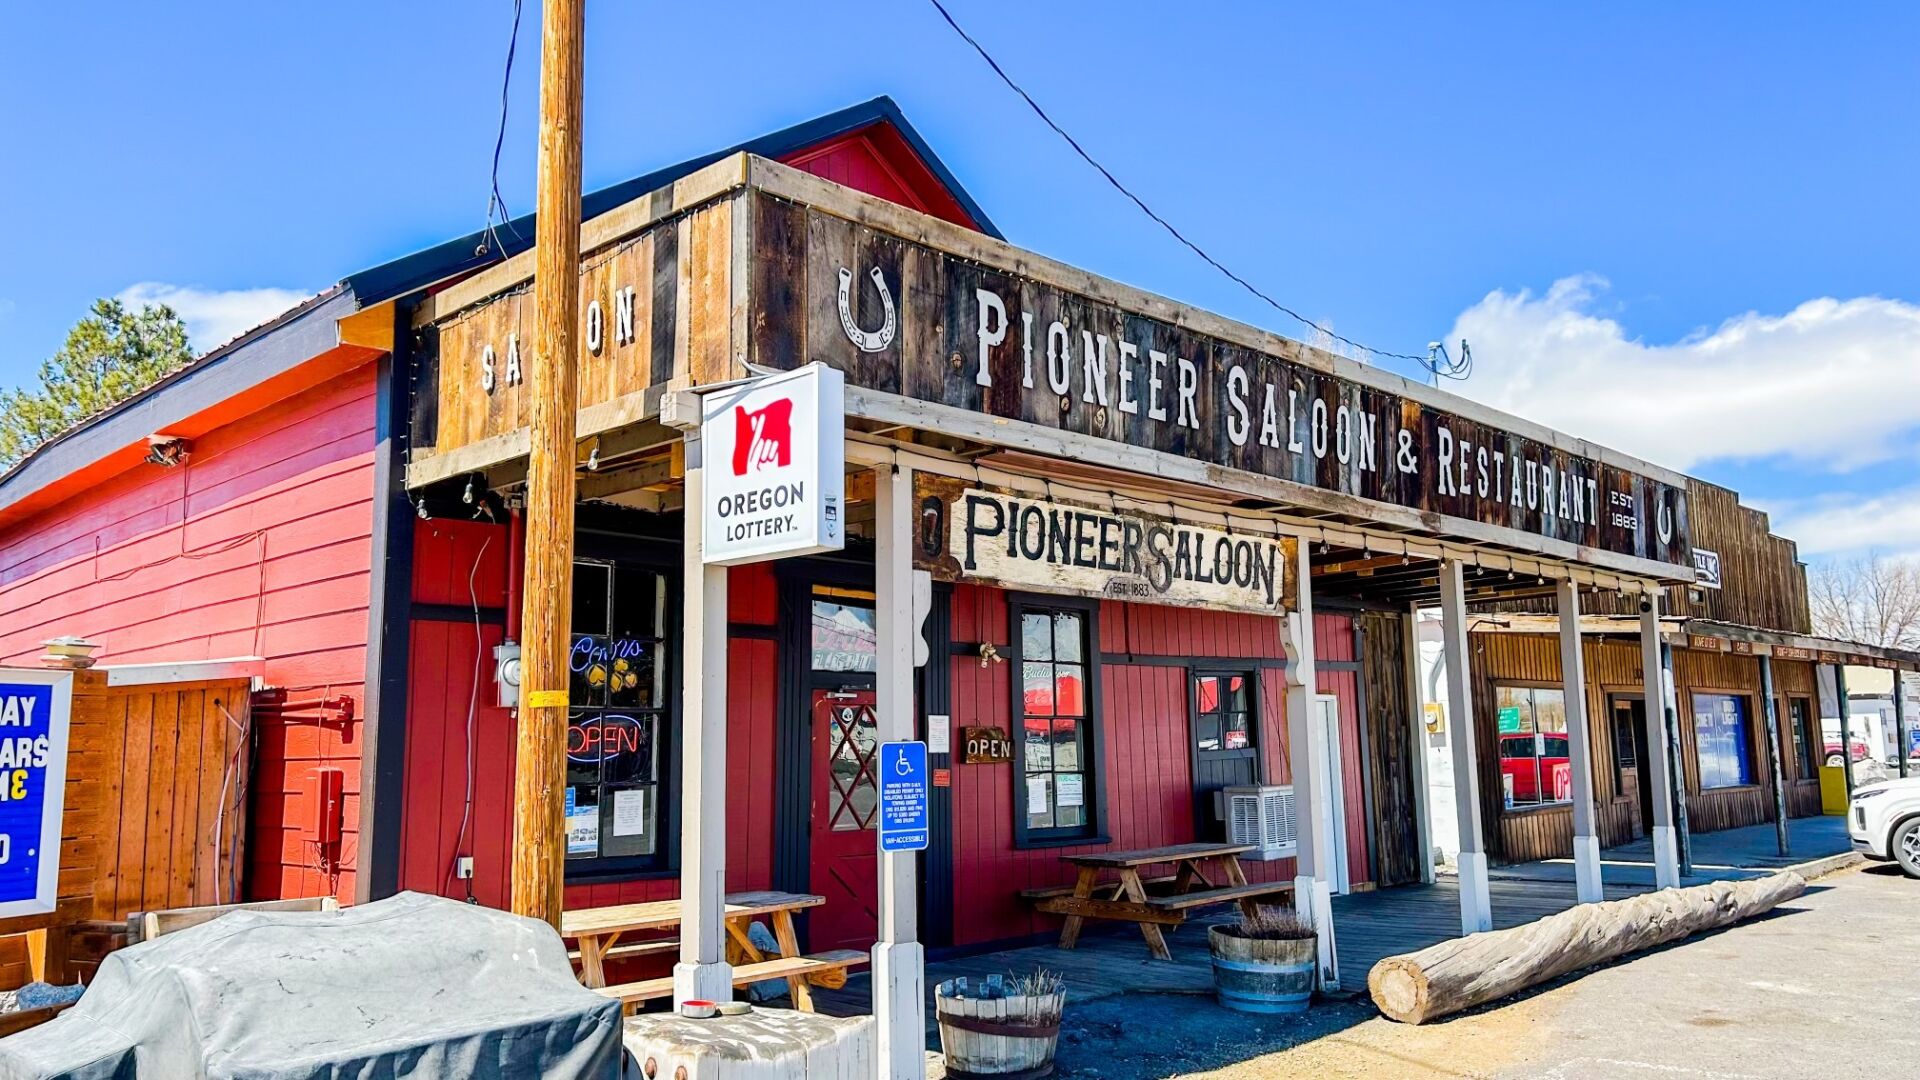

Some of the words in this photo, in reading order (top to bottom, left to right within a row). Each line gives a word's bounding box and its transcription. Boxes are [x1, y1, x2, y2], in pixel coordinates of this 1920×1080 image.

[975, 287, 1200, 431] PIONEER
[1226, 364, 1377, 472] SALOON
[1397, 429, 1418, 475] &
[1437, 426, 1597, 527] RESTAURANT
[717, 481, 804, 518] OREGON
[1611, 490, 1633, 509] EST
[1611, 512, 1638, 530] 1883
[963, 494, 1143, 574] PIONEER
[1141, 523, 1277, 605] SALOON
[0, 695, 36, 727] AY
[567, 726, 638, 752] OPEN
[967, 739, 1010, 758] OPEN
